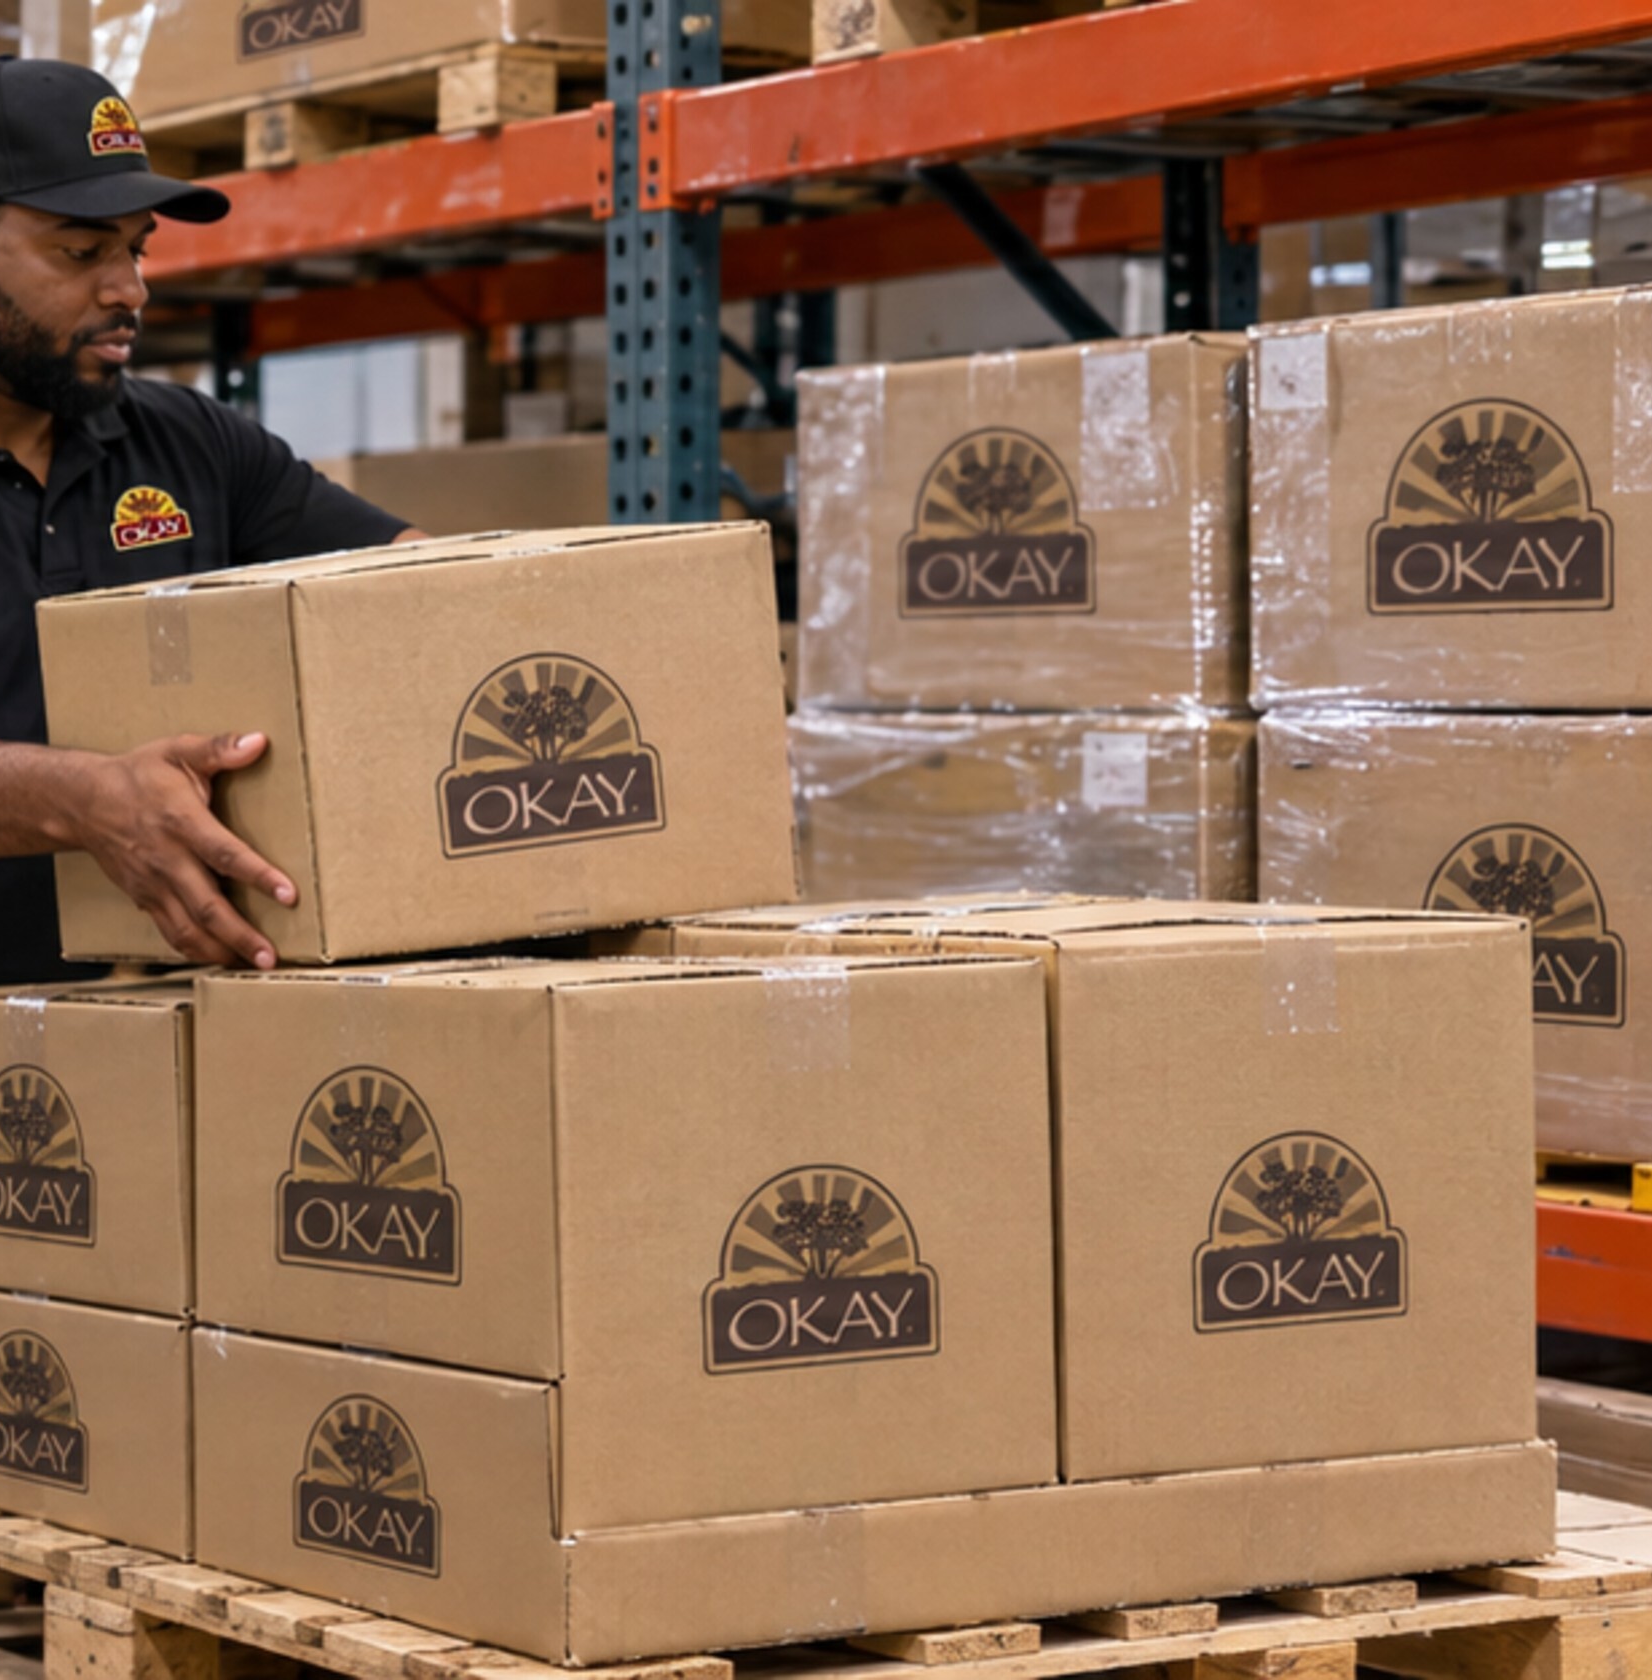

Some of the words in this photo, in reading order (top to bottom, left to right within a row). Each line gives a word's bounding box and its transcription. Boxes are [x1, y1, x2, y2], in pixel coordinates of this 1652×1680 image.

[249, 0, 351, 49] OKAY
[918, 546, 1074, 600] OKAY
[1392, 535, 1584, 595] OKAY
[463, 767, 637, 835] OKAY
[1532, 951, 1599, 1004] AY
[295, 1196, 441, 1260] OKAY
[1216, 1250, 1385, 1312] OKAY
[728, 1287, 914, 1351] OKAY
[308, 1495, 424, 1556] OKAY
